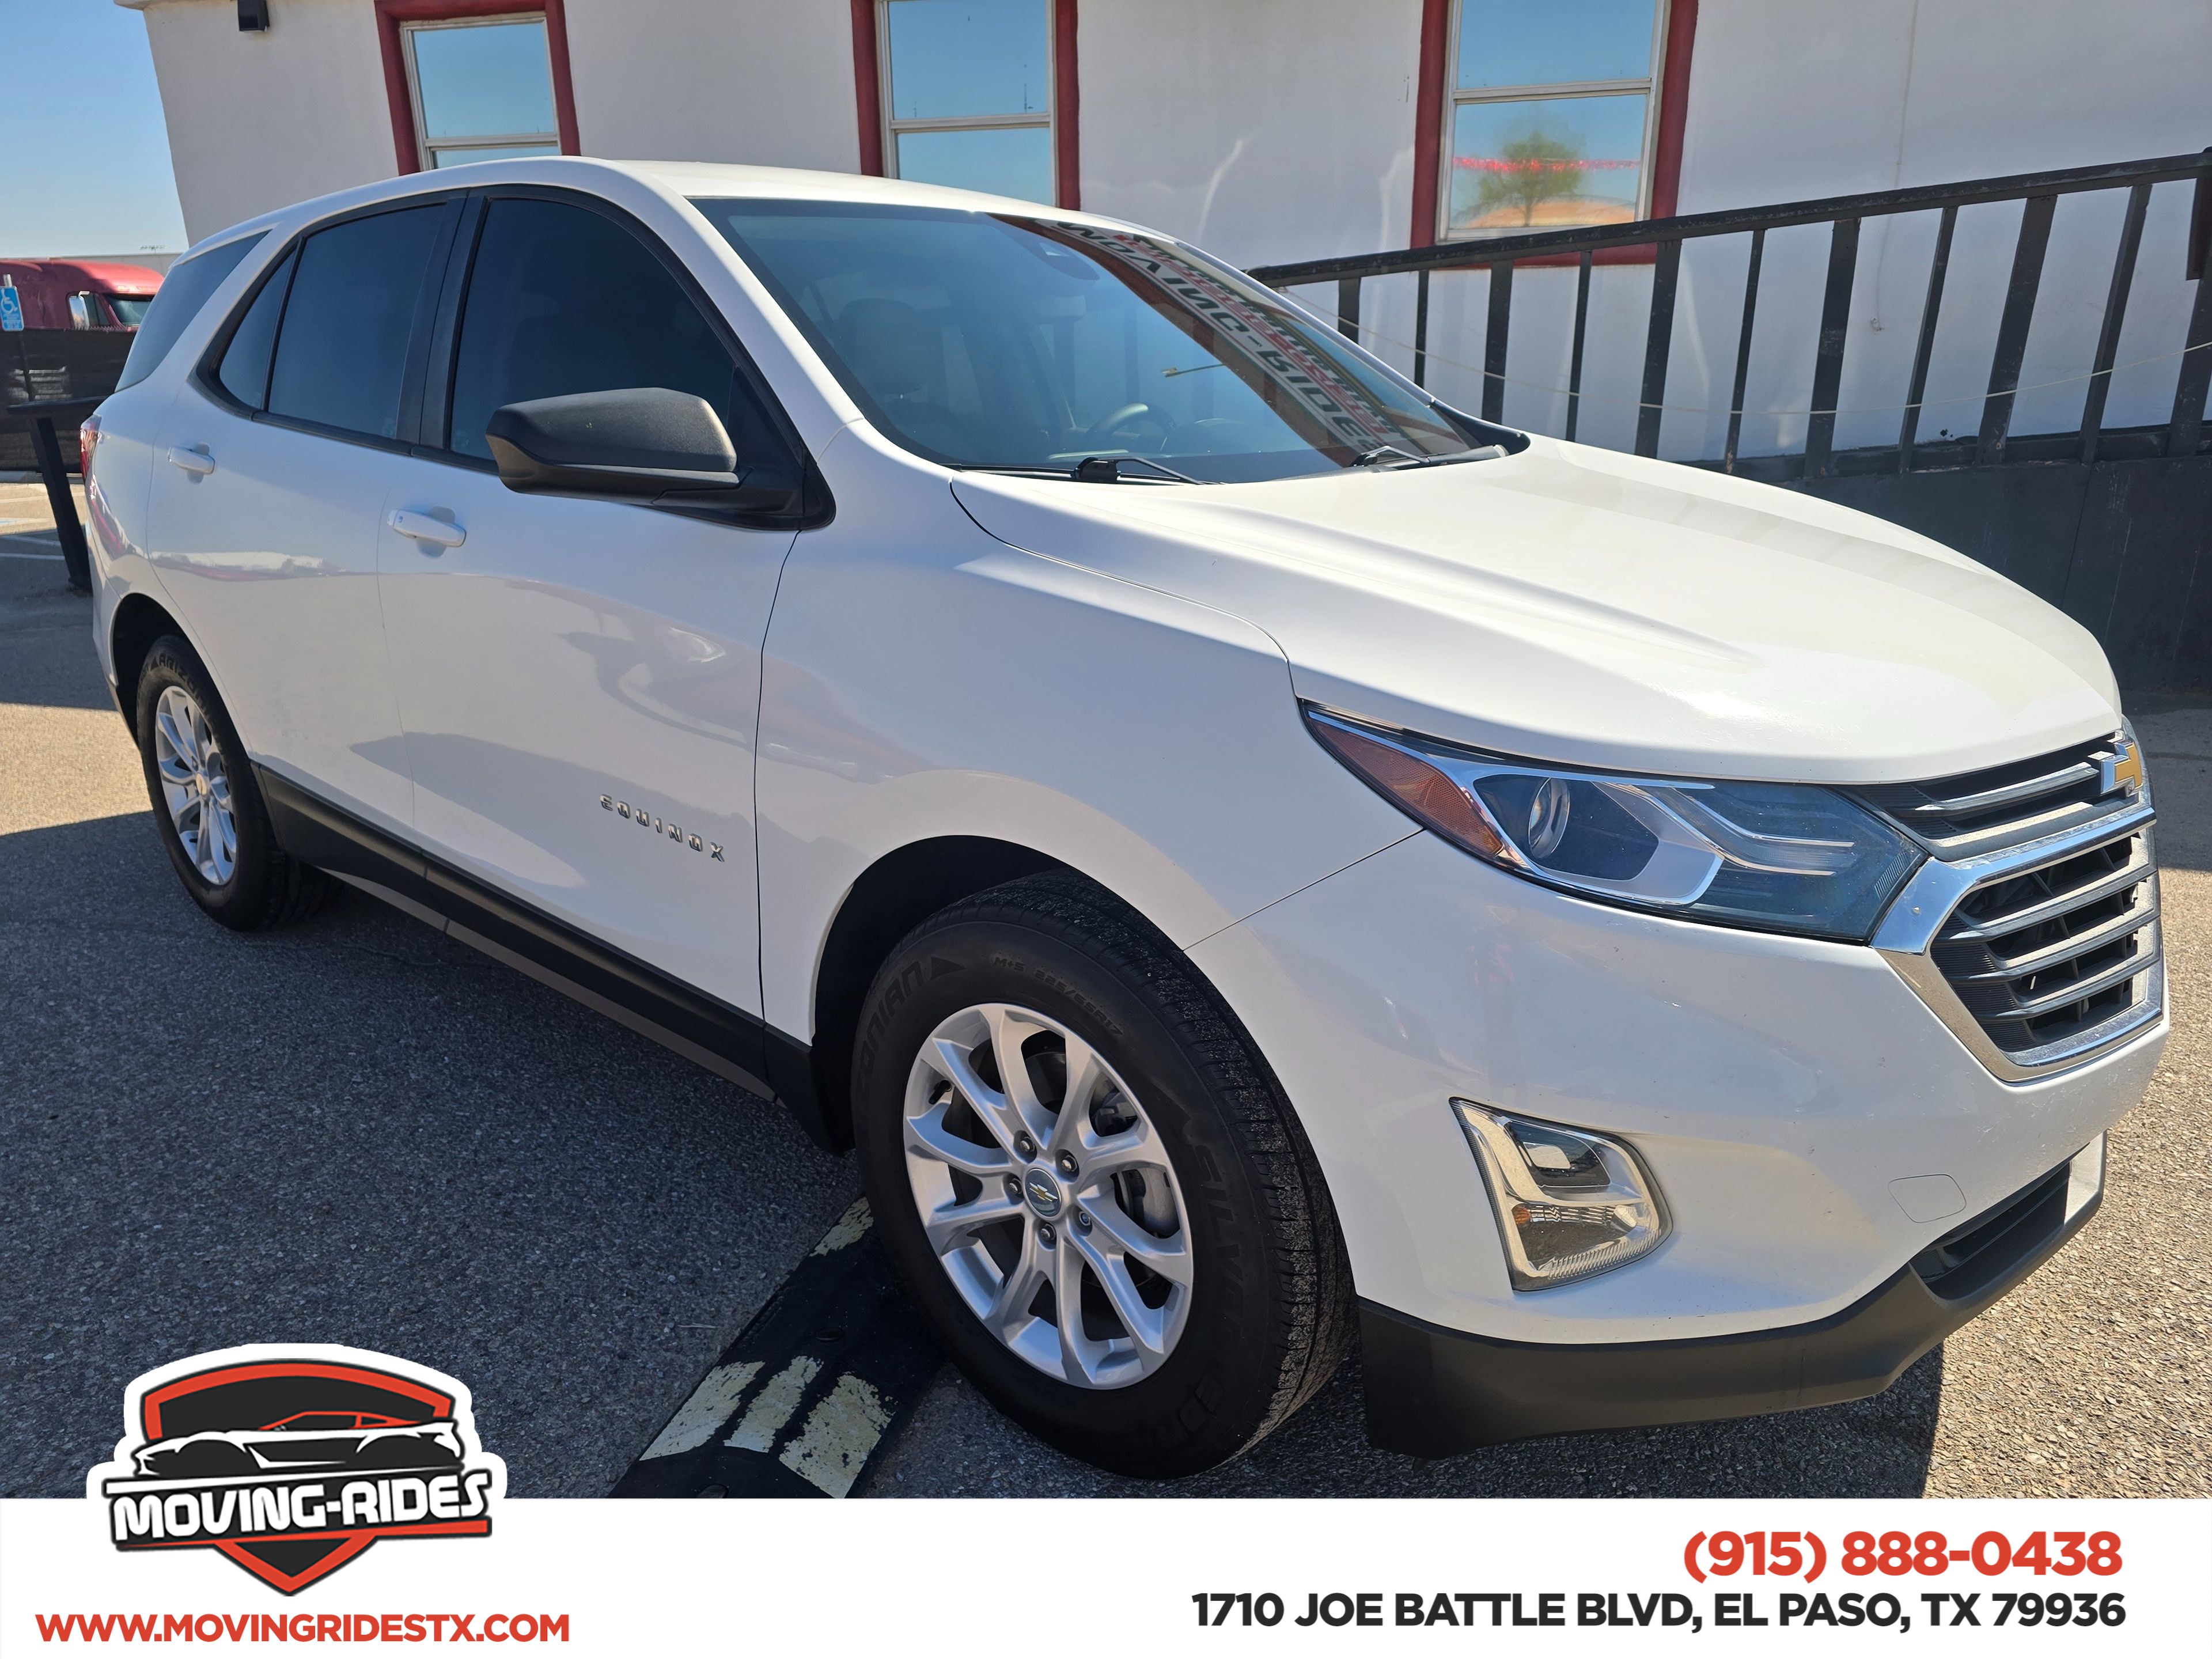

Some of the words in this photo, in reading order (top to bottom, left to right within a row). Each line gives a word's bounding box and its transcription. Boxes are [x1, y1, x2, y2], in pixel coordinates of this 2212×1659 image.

[599, 793, 725, 862] EQUINOX
[994, 957, 1025, 972] M+S
[1034, 969, 1124, 1035] 225/65R17
